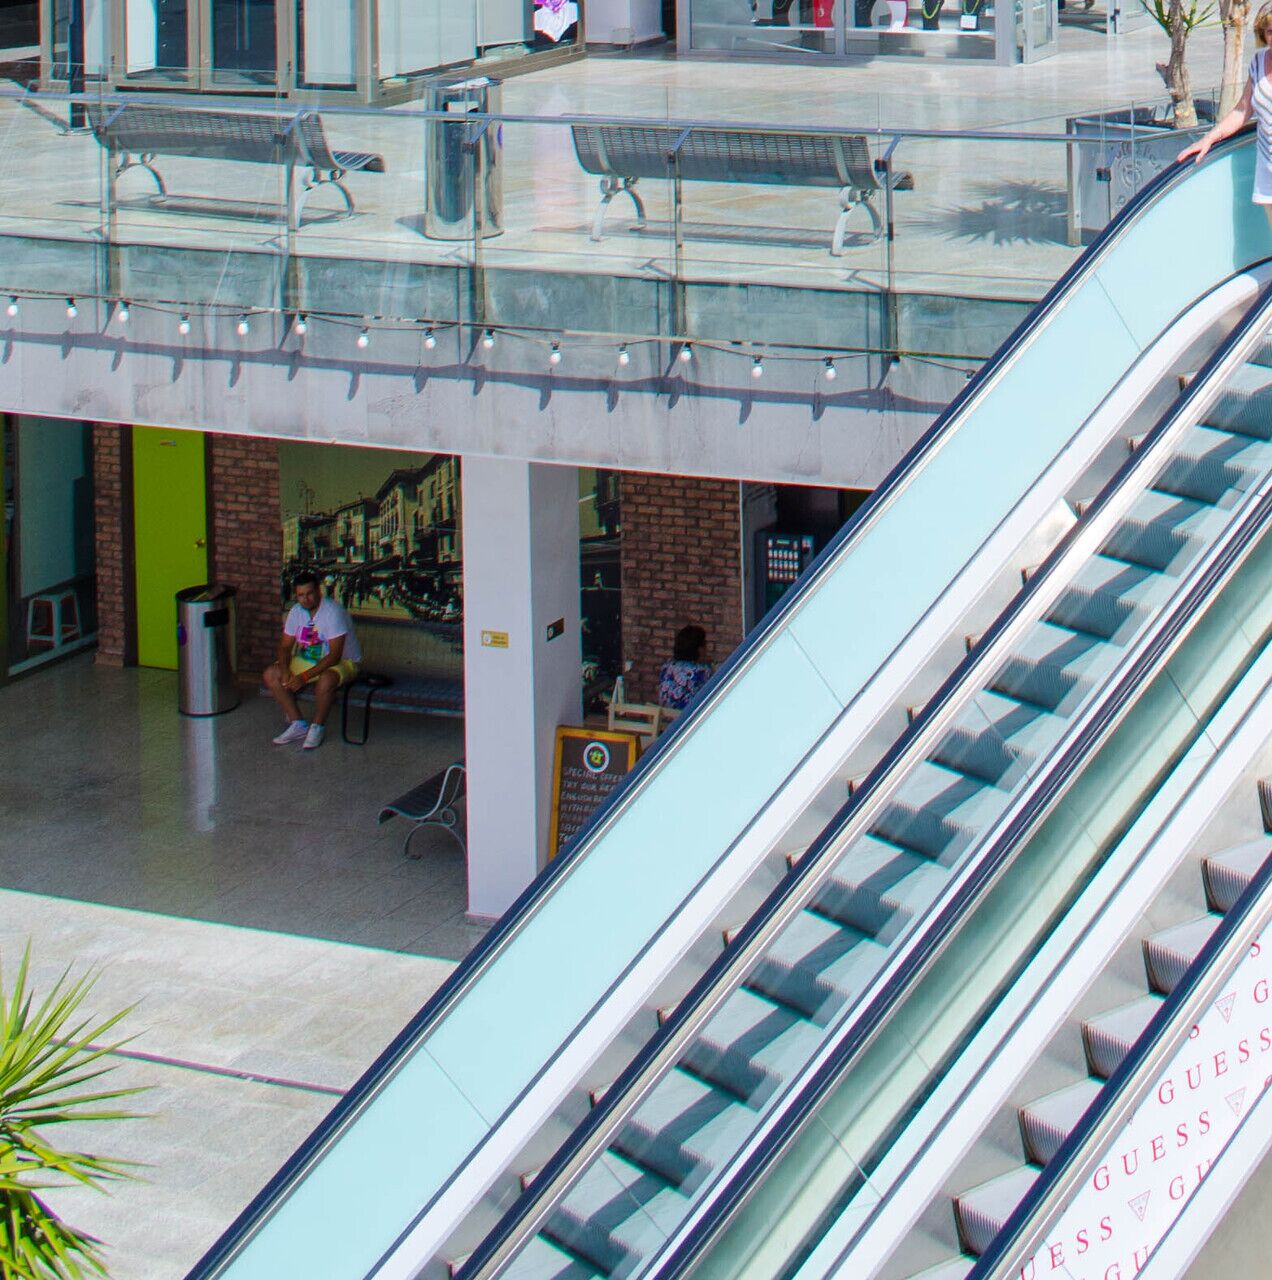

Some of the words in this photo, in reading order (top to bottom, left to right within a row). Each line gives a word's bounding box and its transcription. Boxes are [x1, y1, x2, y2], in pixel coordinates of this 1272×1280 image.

[1158, 1027, 1272, 1105] GUESS
[1093, 1111, 1211, 1192] GUESS
[1020, 1216, 1113, 1280] UESS
